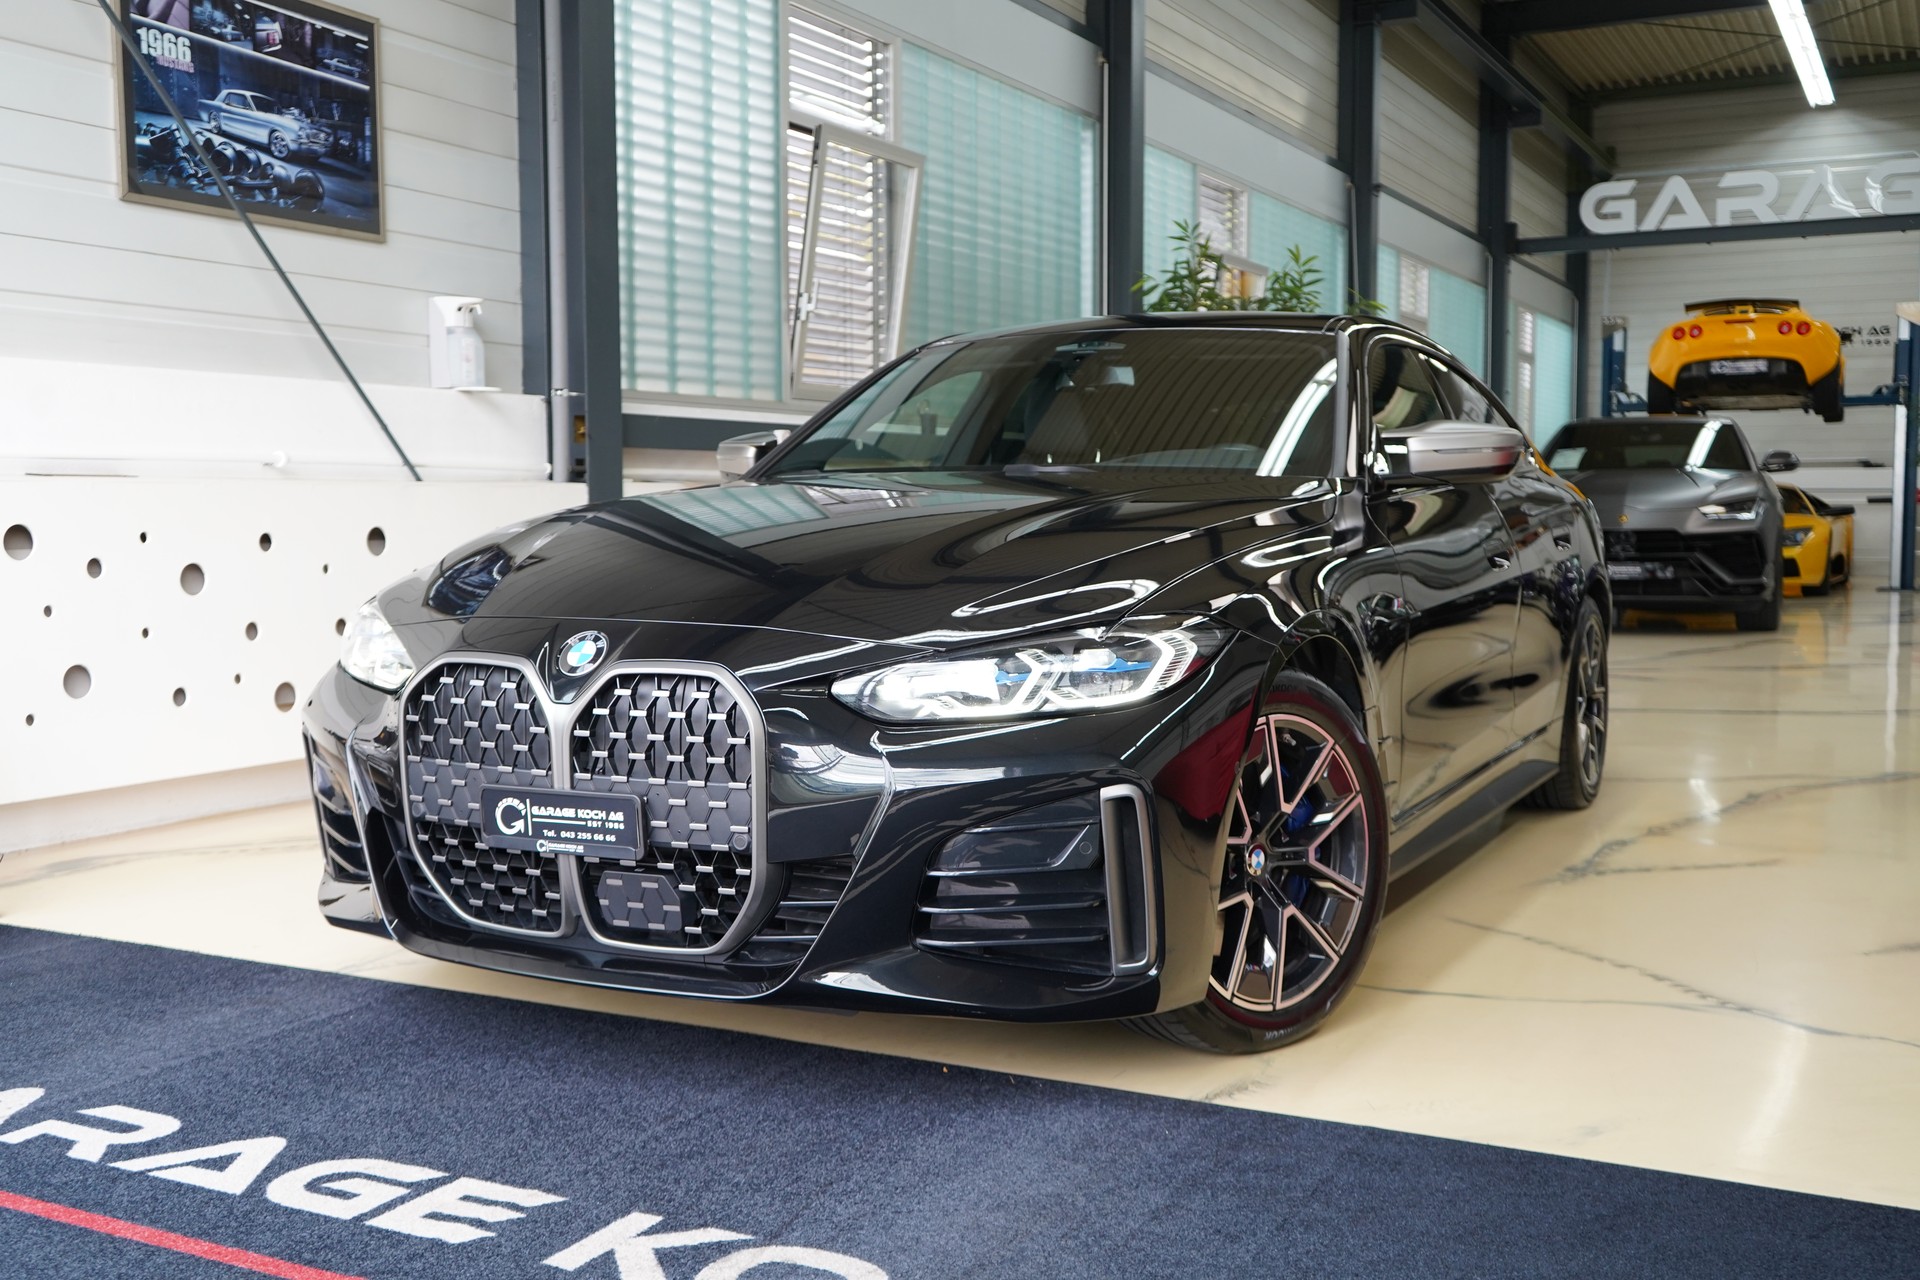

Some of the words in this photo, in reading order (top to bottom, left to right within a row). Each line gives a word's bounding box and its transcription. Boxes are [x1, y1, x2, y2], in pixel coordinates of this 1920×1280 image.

[136, 26, 192, 63] 1966
[531, 805, 576, 818] GARAGE
[577, 808, 607, 820] KOCH
[608, 811, 625, 822] AG
[587, 820, 602, 828] EST
[560, 830, 576, 838] 043
[576, 832, 592, 840] 255
[593, 833, 604, 841] 66
[605, 834, 617, 842] 66
